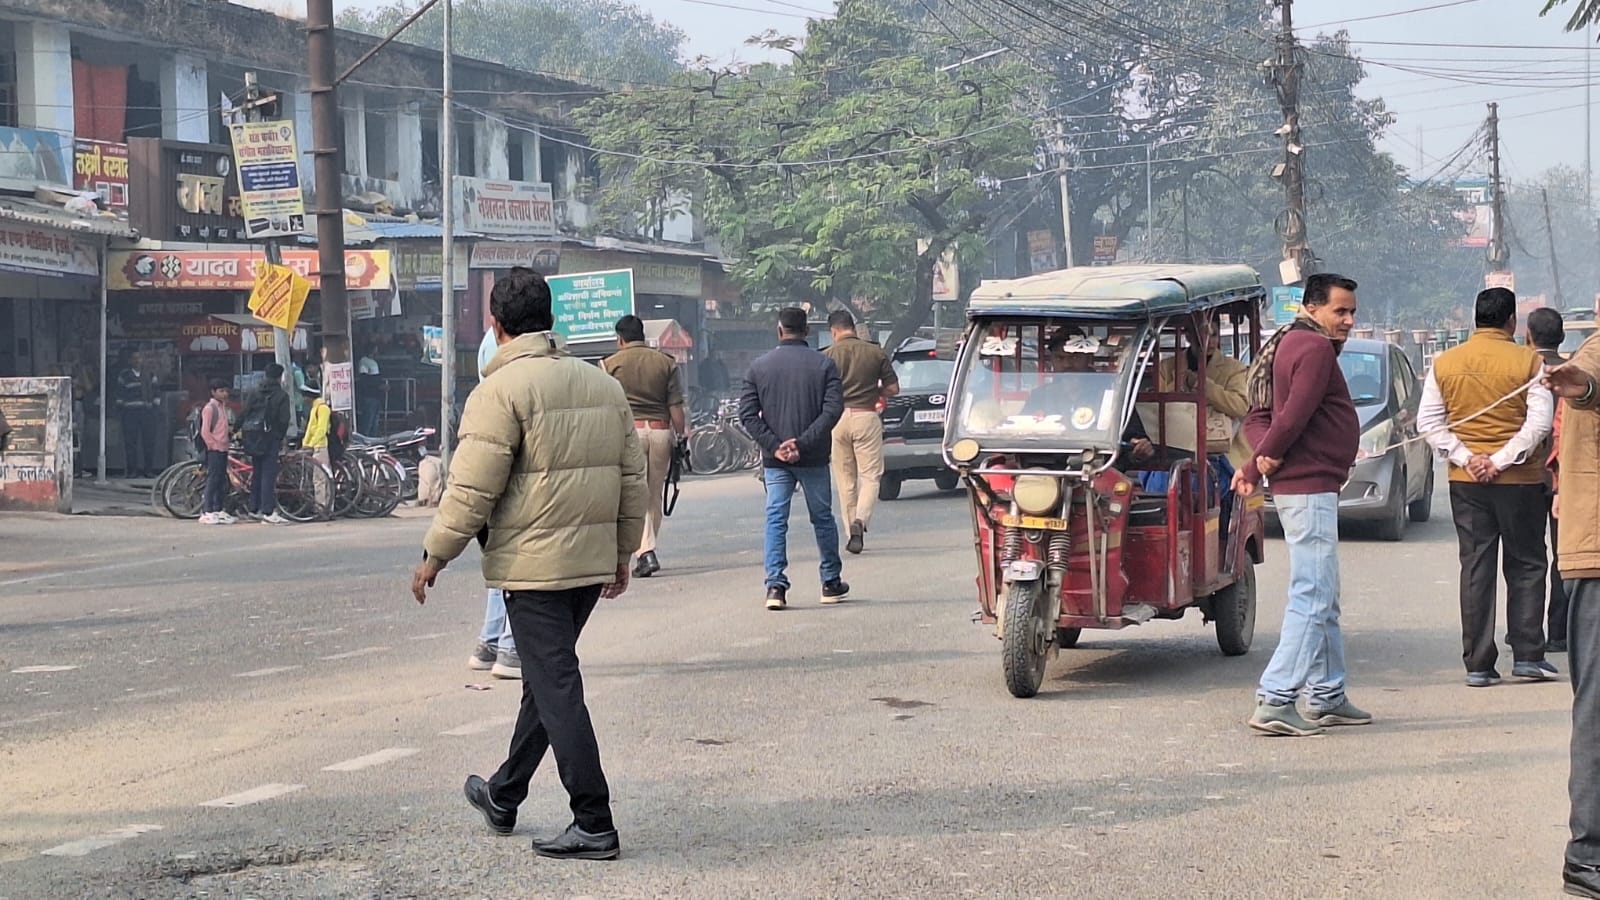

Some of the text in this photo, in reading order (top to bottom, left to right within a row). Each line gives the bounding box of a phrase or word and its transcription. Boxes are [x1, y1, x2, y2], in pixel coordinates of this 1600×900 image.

[75, 145, 101, 181] लक्ष्मी
[477, 190, 507, 219] नेशनल
[185, 257, 239, 277] यादव
[210, 324, 239, 337] पनीर
